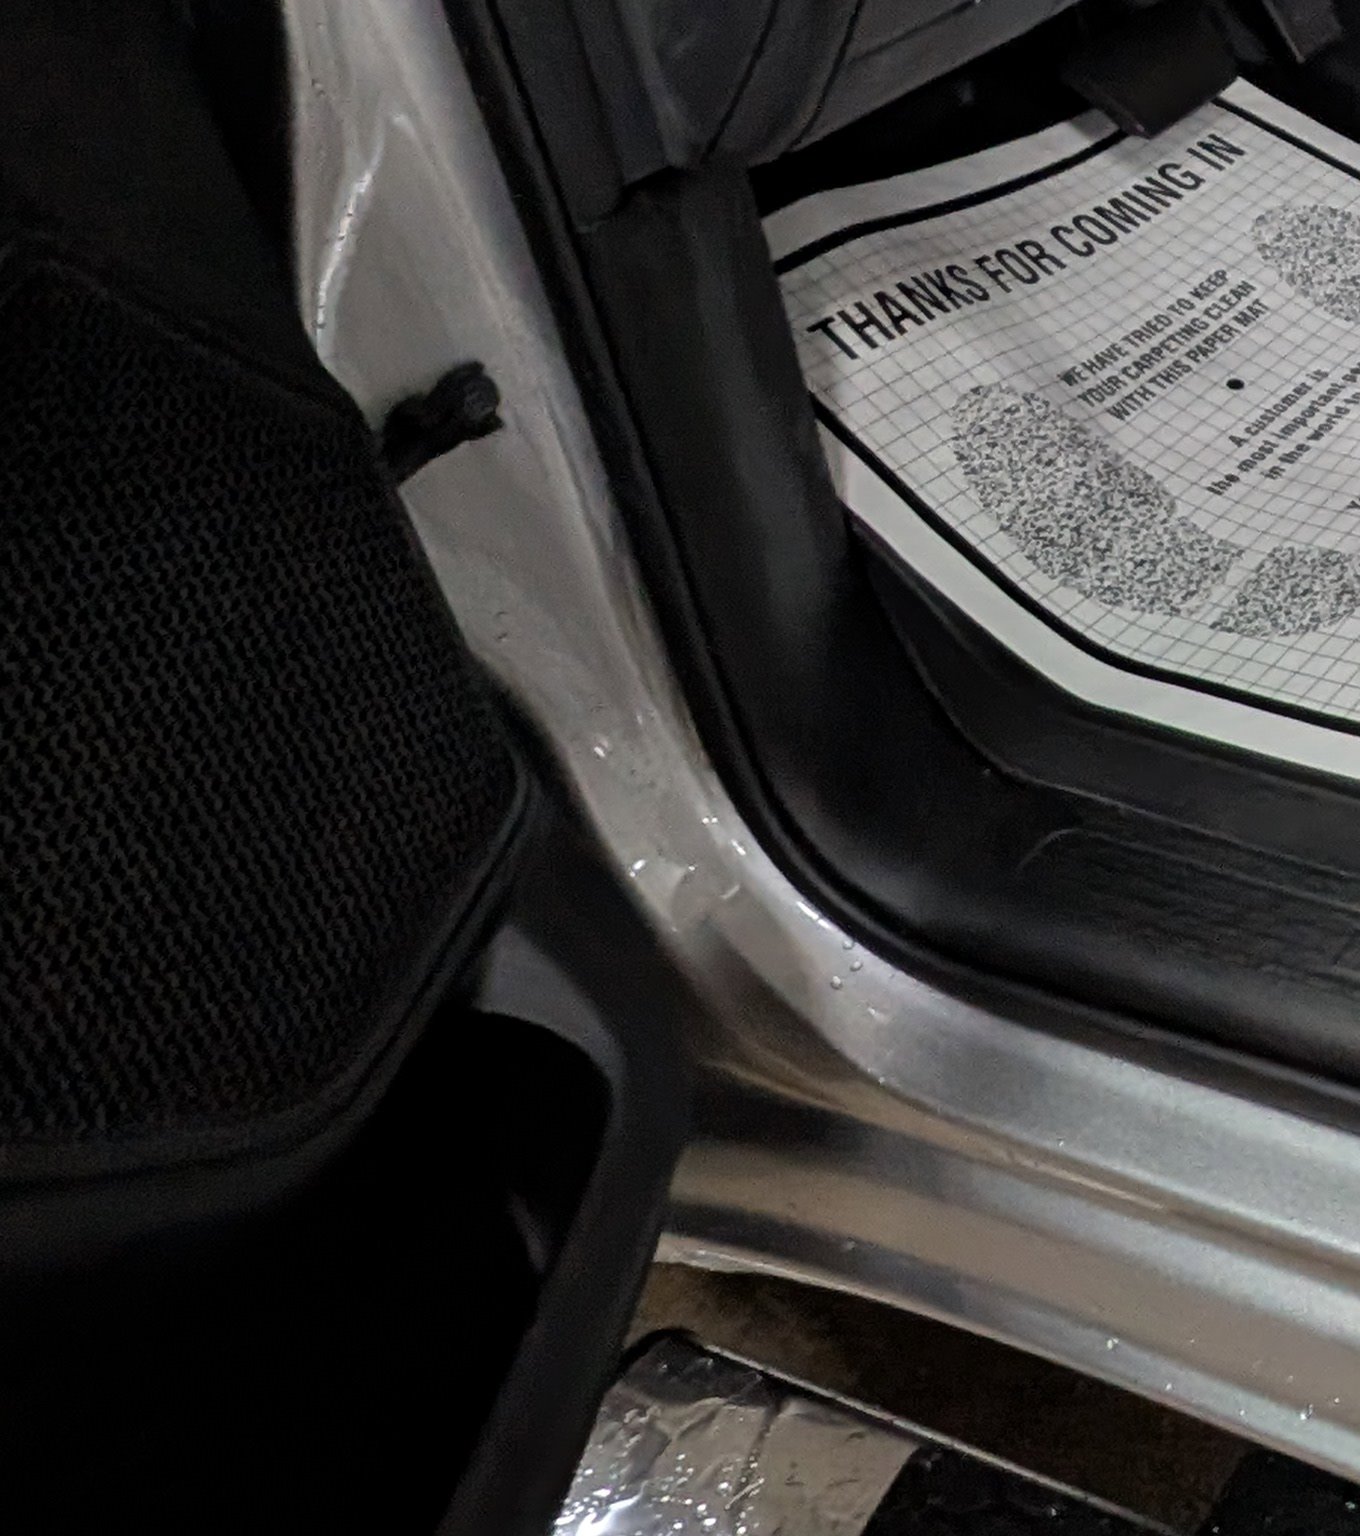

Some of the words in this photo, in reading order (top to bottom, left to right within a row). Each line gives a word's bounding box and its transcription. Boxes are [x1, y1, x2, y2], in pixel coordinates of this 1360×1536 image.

[807, 261, 991, 360] THANKS
[976, 236, 1067, 289] FOR
[1050, 160, 1205, 260] COMING
[1186, 132, 1248, 173] IN
[1059, 366, 1088, 386] WE
[1081, 343, 1129, 375] HAVE
[1120, 314, 1173, 348] TRIED
[1167, 297, 1196, 316] TO
[1189, 270, 1229, 301] KEEP
[1077, 375, 1128, 408] YOUR
[1121, 317, 1210, 380] CARPETING
[1202, 280, 1256, 320] CLEAN
[1105, 385, 1157, 421] WITH
[1147, 359, 1193, 390] THIS
[1186, 323, 1240, 364] PAPER
[1232, 298, 1270, 327] MAT
[1206, 473, 1240, 496] the
[1237, 439, 1279, 472] most
[1269, 382, 1346, 440] important
[1228, 434, 1249, 448] A
[1244, 382, 1313, 437] customer
[1306, 368, 1329, 382] is
[1260, 465, 1286, 480] in
[1278, 443, 1311, 464] the
[1306, 406, 1350, 441] world
